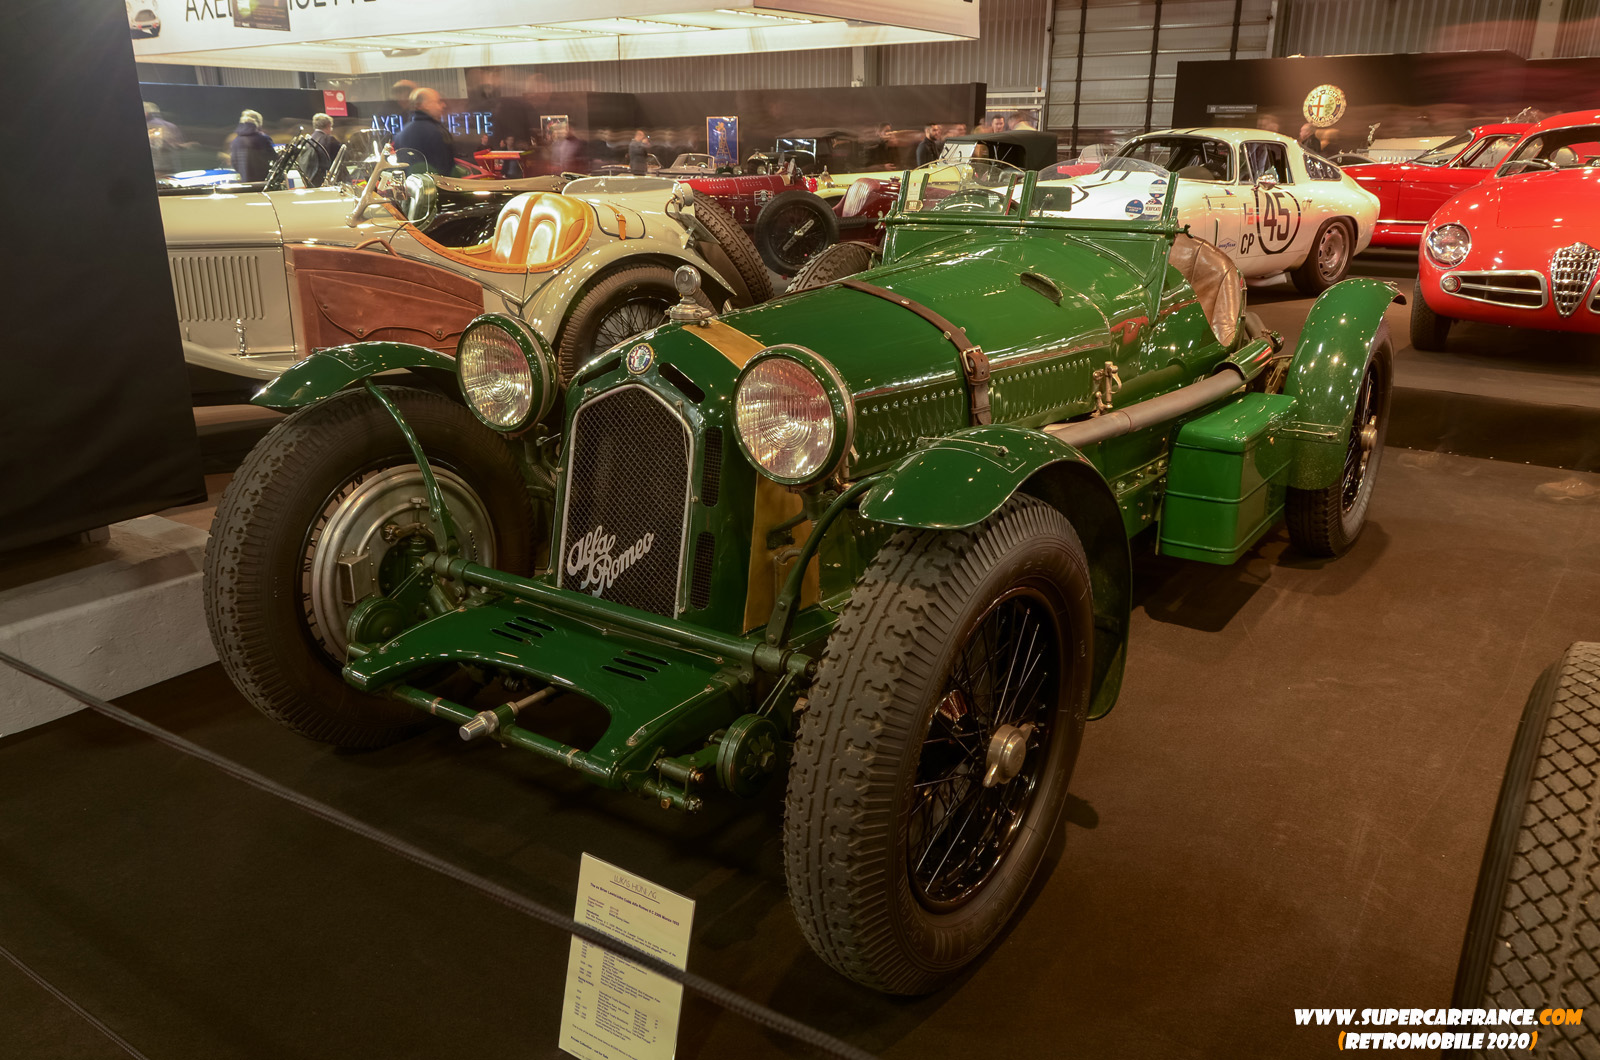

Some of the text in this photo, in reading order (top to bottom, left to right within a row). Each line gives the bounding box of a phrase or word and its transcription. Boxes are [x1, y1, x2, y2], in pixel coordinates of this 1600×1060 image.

[1263, 192, 1290, 242] 45
[1240, 232, 1255, 255] CP
[590, 532, 655, 598] Romeo
